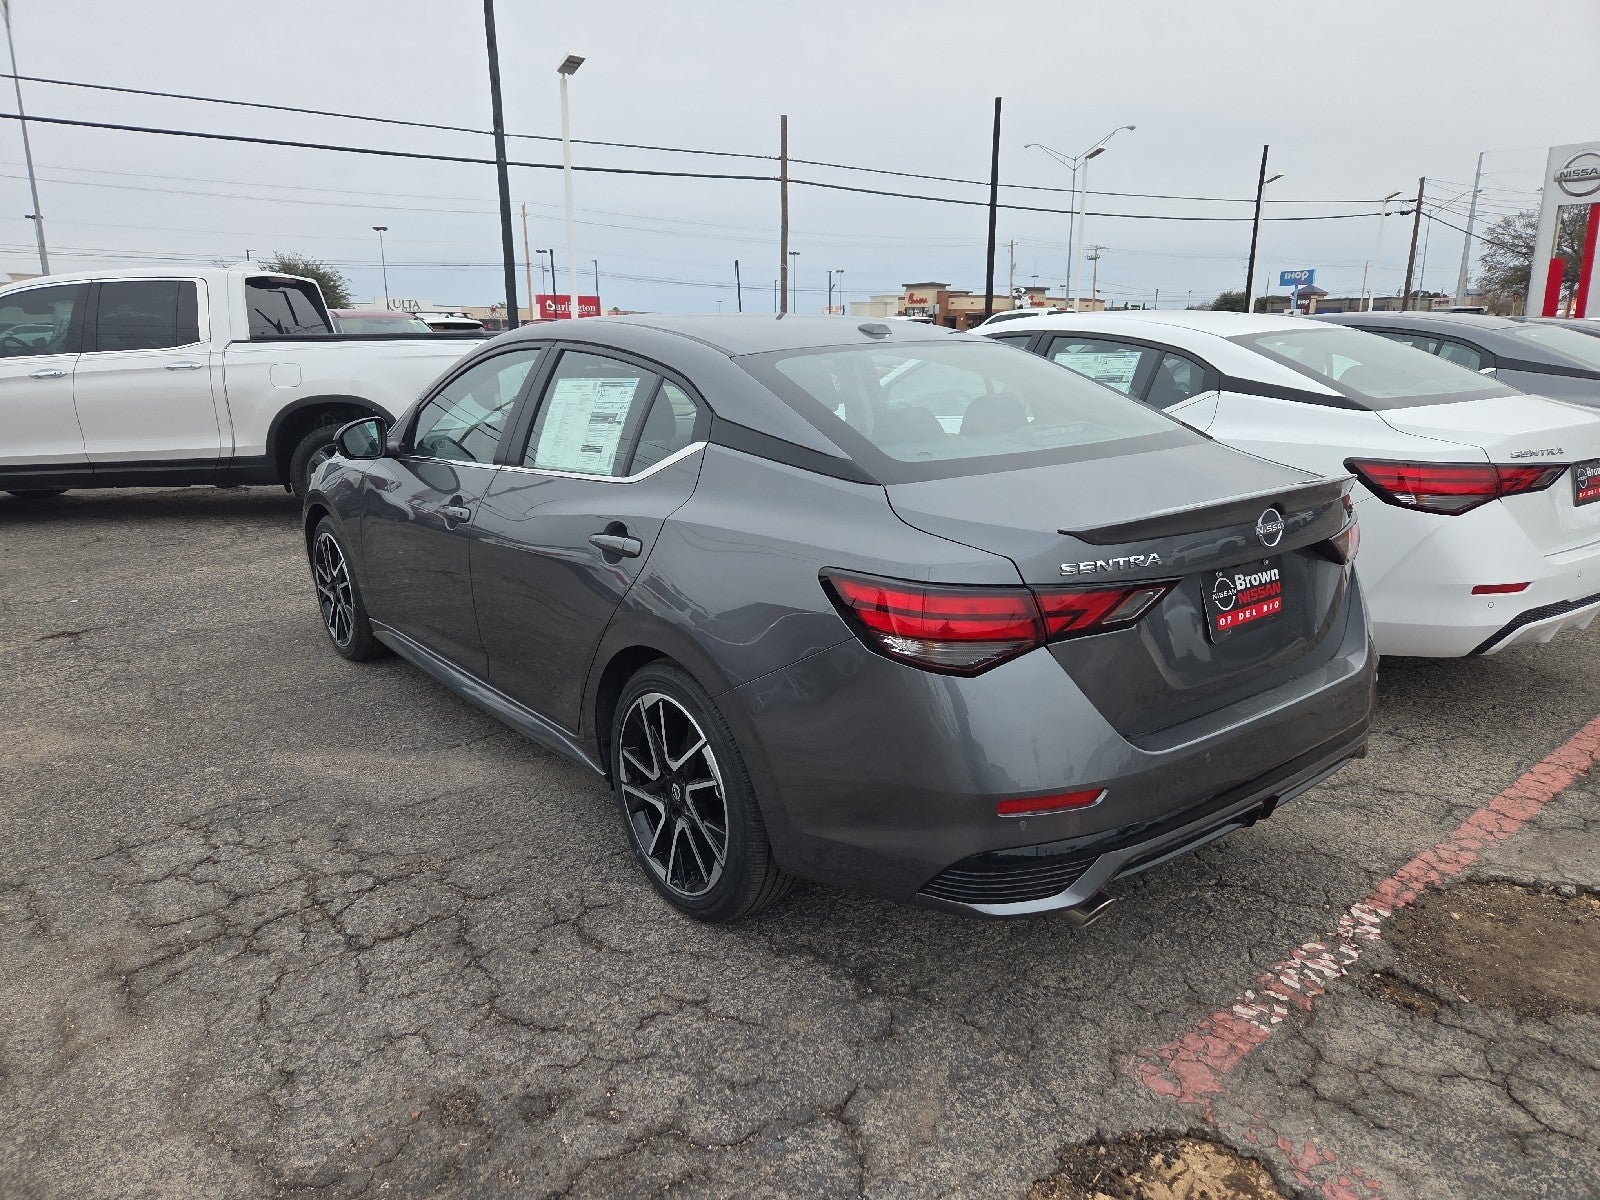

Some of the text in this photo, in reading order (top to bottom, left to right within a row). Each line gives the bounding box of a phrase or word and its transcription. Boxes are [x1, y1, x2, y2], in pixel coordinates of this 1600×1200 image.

[1560, 168, 1599, 178] NISSA
[392, 298, 421, 310] ULTA
[546, 299, 596, 314] Burligton
[1510, 447, 1564, 459] SENTRA
[1059, 552, 1162, 576] SENTRA
[1234, 568, 1280, 591] Brown
[1212, 588, 1237, 600] NISSAN
[1238, 581, 1281, 604] NISSAN
[1219, 601, 1280, 626] OF DEL RIO
